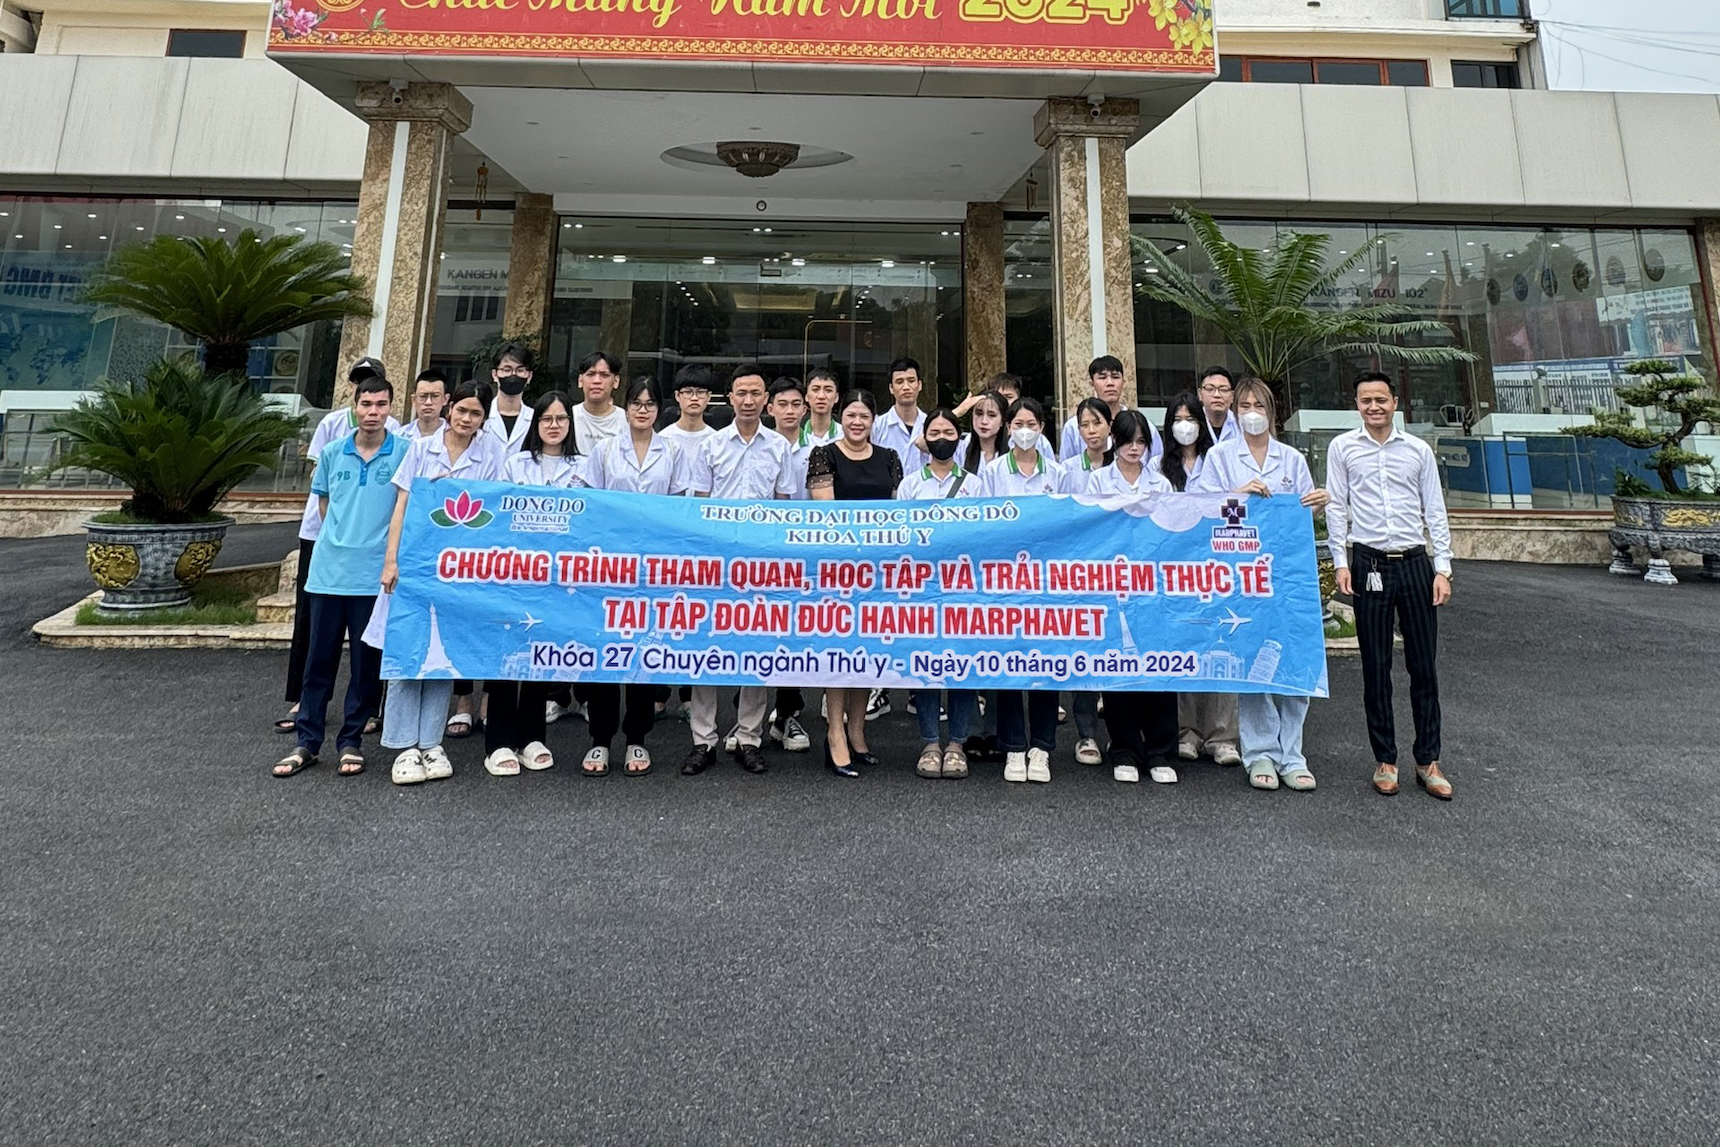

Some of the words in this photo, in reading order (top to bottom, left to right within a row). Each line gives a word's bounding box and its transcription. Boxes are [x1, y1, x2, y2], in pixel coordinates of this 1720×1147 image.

[447, 269, 497, 279] KANGEN
[1368, 289, 1395, 298] MIZU
[502, 497, 554, 512] DONG
[559, 499, 584, 513] DO
[513, 514, 569, 523] UNIVERSITY
[702, 506, 801, 523] TRƯỜNG
[855, 510, 906, 526] HỌC
[788, 530, 857, 545] KHOA
[861, 527, 910, 544] THÚ
[917, 530, 932, 544] Y
[1213, 541, 1235, 551] WHO
[1238, 541, 1260, 551] GMP
[439, 550, 549, 582] CHƯƠNG
[558, 549, 637, 584] TRÌNH
[646, 558, 722, 587] THAM
[730, 560, 810, 591] QUAN,
[821, 562, 873, 594] HỌC
[883, 558, 932, 595] TẬP
[941, 558, 974, 589] VÀ
[982, 553, 1040, 591] TRẢI
[1050, 558, 1154, 598] NGHIỆM
[1163, 561, 1230, 599] THỰC
[1239, 557, 1270, 593] TẾ
[606, 600, 646, 636] TẠI
[656, 596, 706, 636] TẬP
[714, 598, 789, 632] ĐOÀN
[797, 598, 851, 633] ĐỨC
[862, 605, 934, 640] HẠNH
[945, 607, 1104, 636] MARPHAVET
[533, 644, 594, 668] Khóa
[605, 647, 633, 667] 27
[644, 648, 735, 674] Chuyên
[744, 649, 819, 676] ngành
[826, 649, 866, 672] Thú
[874, 658, 887, 677] y
[914, 653, 969, 677] Ngày
[977, 655, 999, 672] 10
[1006, 653, 1070, 677] tháng
[1074, 655, 1086, 672] 6
[1093, 653, 1138, 672] năm
[1146, 655, 1195, 672] 2024
